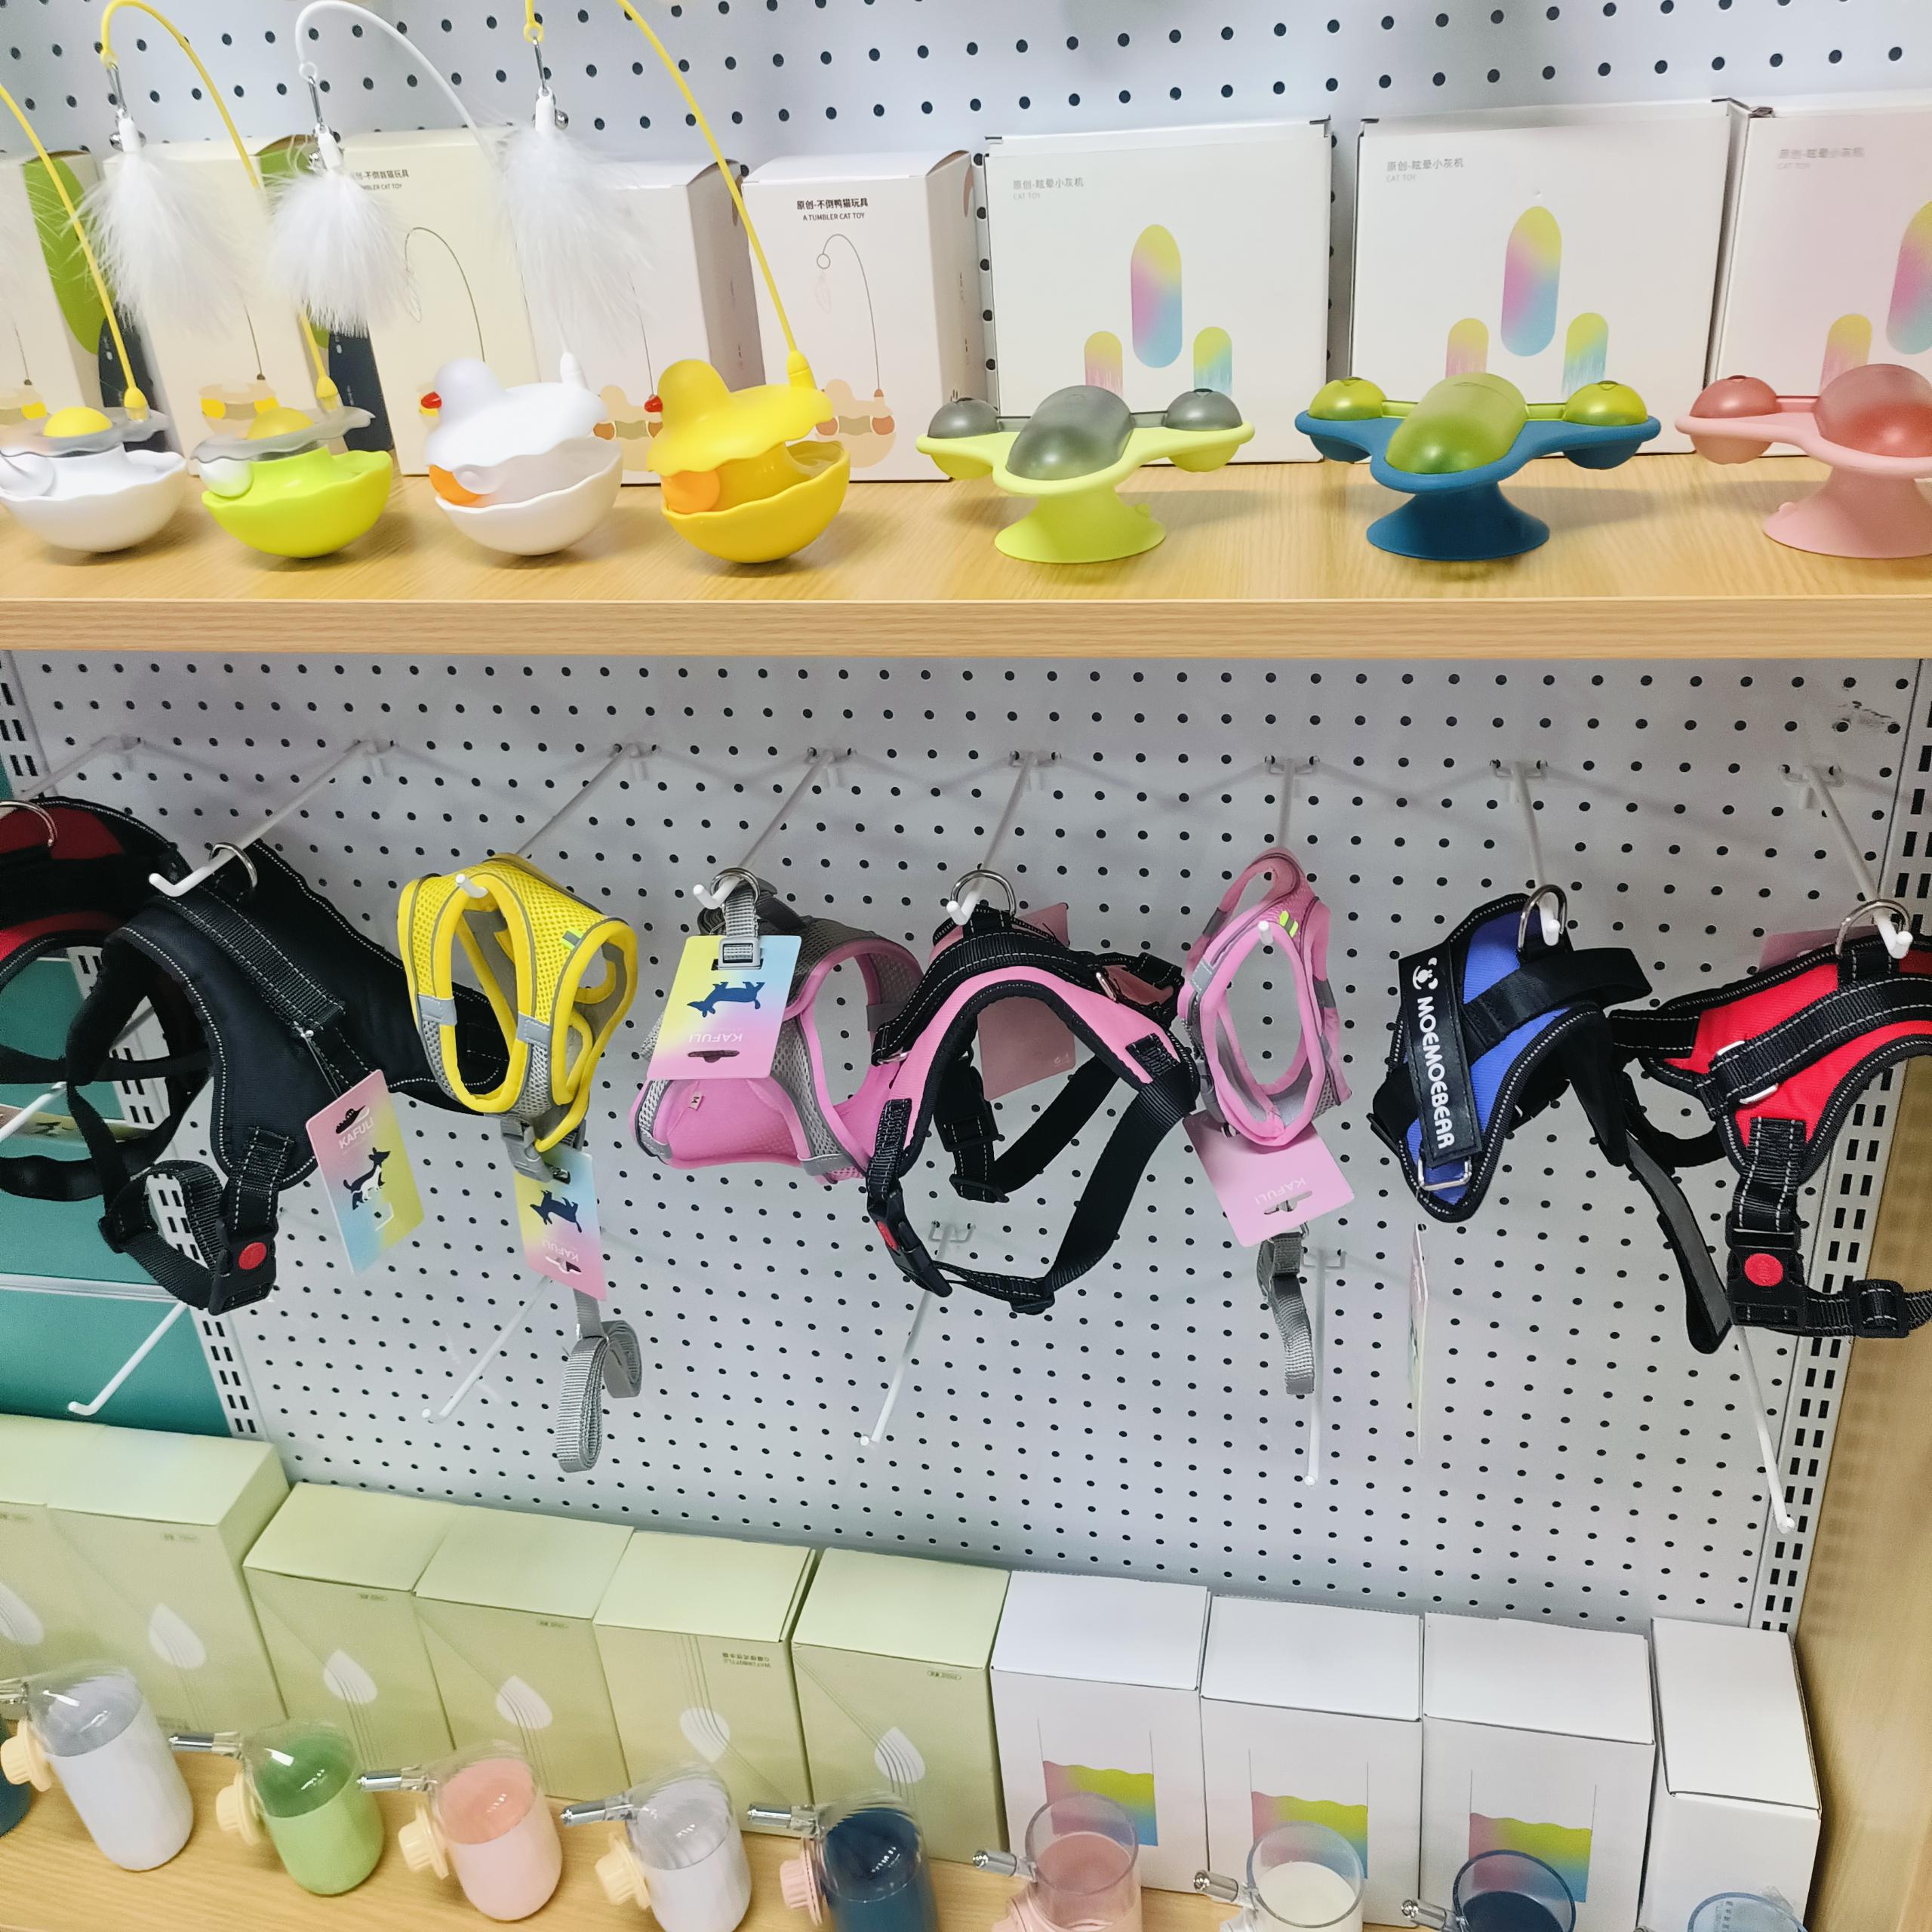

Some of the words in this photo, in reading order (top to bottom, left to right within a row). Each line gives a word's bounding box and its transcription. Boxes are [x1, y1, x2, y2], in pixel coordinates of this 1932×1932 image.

[688, 1033, 743, 1043] KAFULI
[1417, 996, 1455, 1149] MOEMOEBEAR
[338, 1117, 374, 1149] KAFULI
[1254, 1177, 1306, 1206] KAFULI
